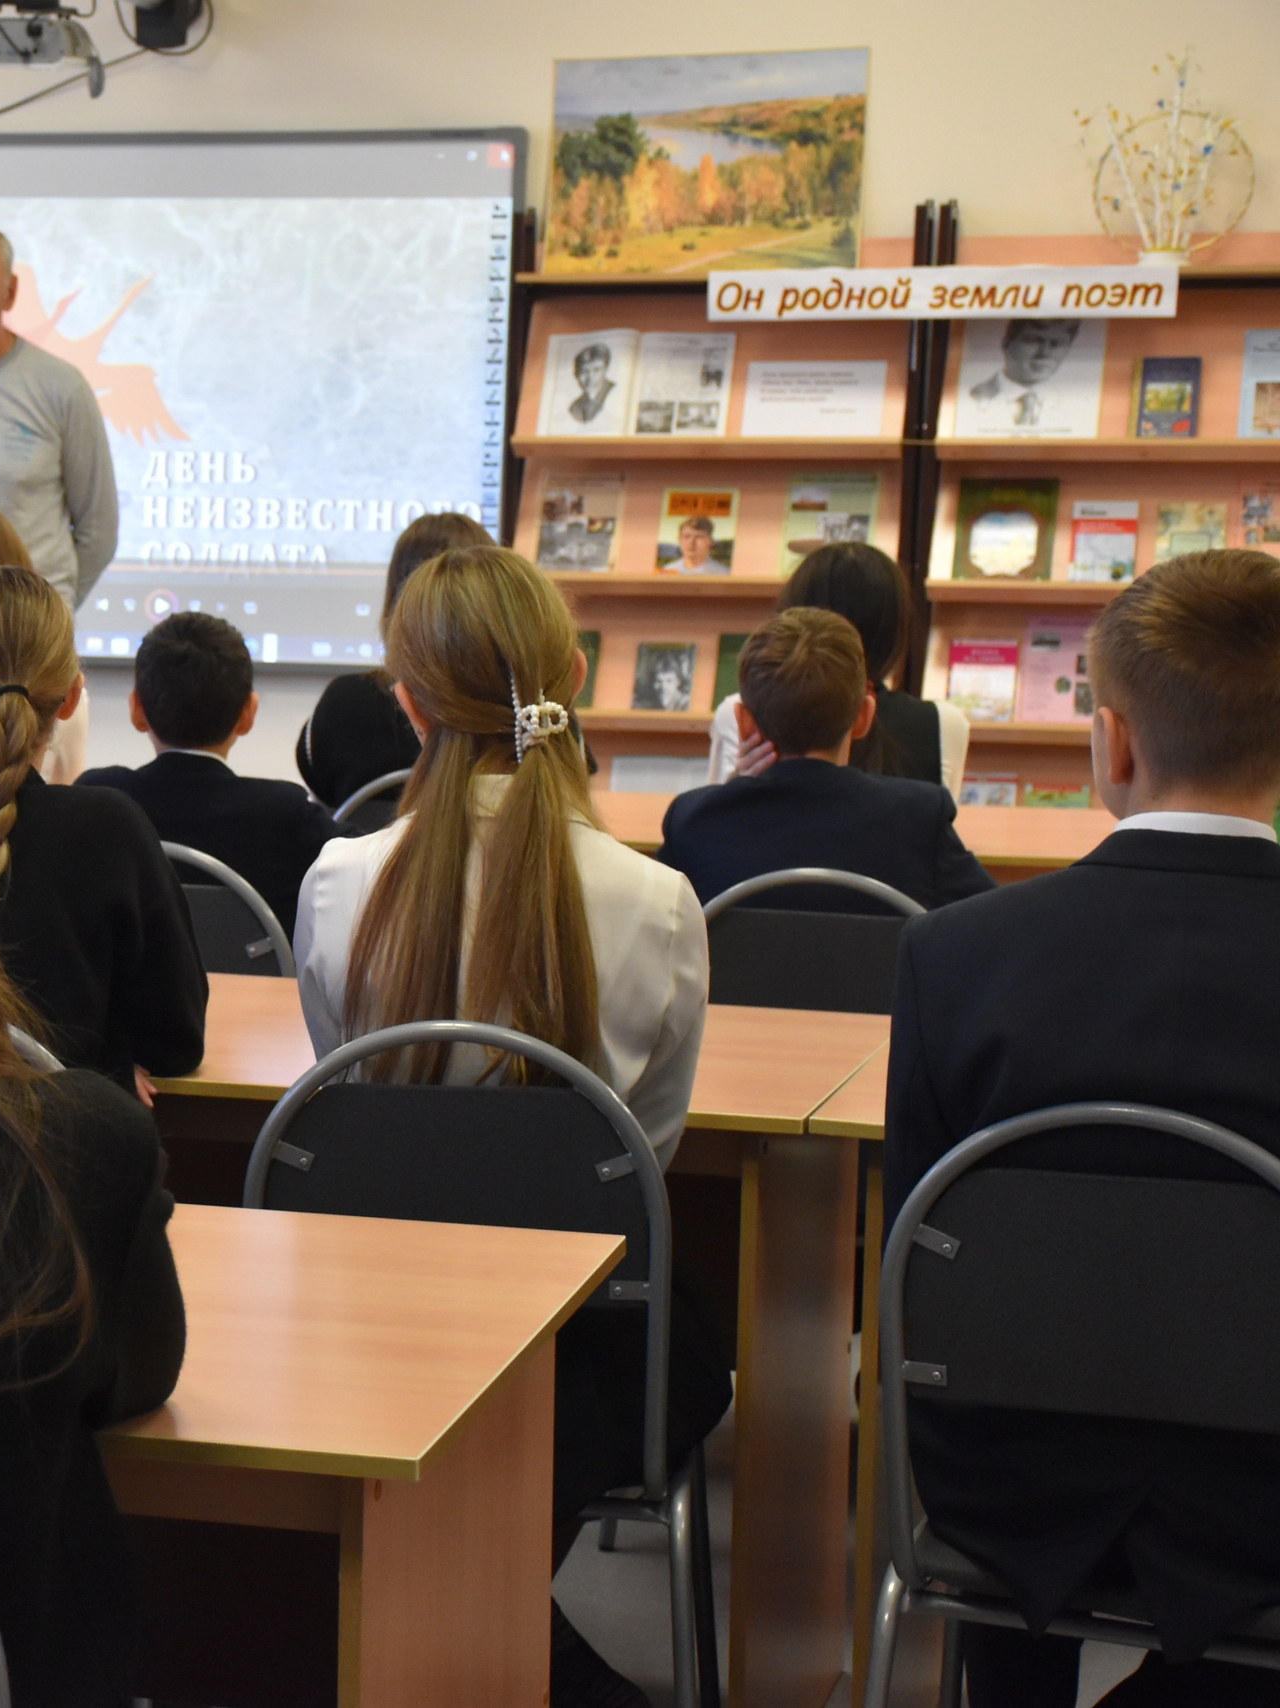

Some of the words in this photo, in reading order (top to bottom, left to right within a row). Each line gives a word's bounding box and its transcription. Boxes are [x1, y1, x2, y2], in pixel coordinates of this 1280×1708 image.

[716, 281, 764, 312] Он
[778, 277, 912, 318] родной
[928, 282, 1045, 311] земли
[1060, 280, 1164, 309] поэт
[141, 449, 258, 489] ДЕНЬ
[140, 541, 329, 576] СОЛДАТА
